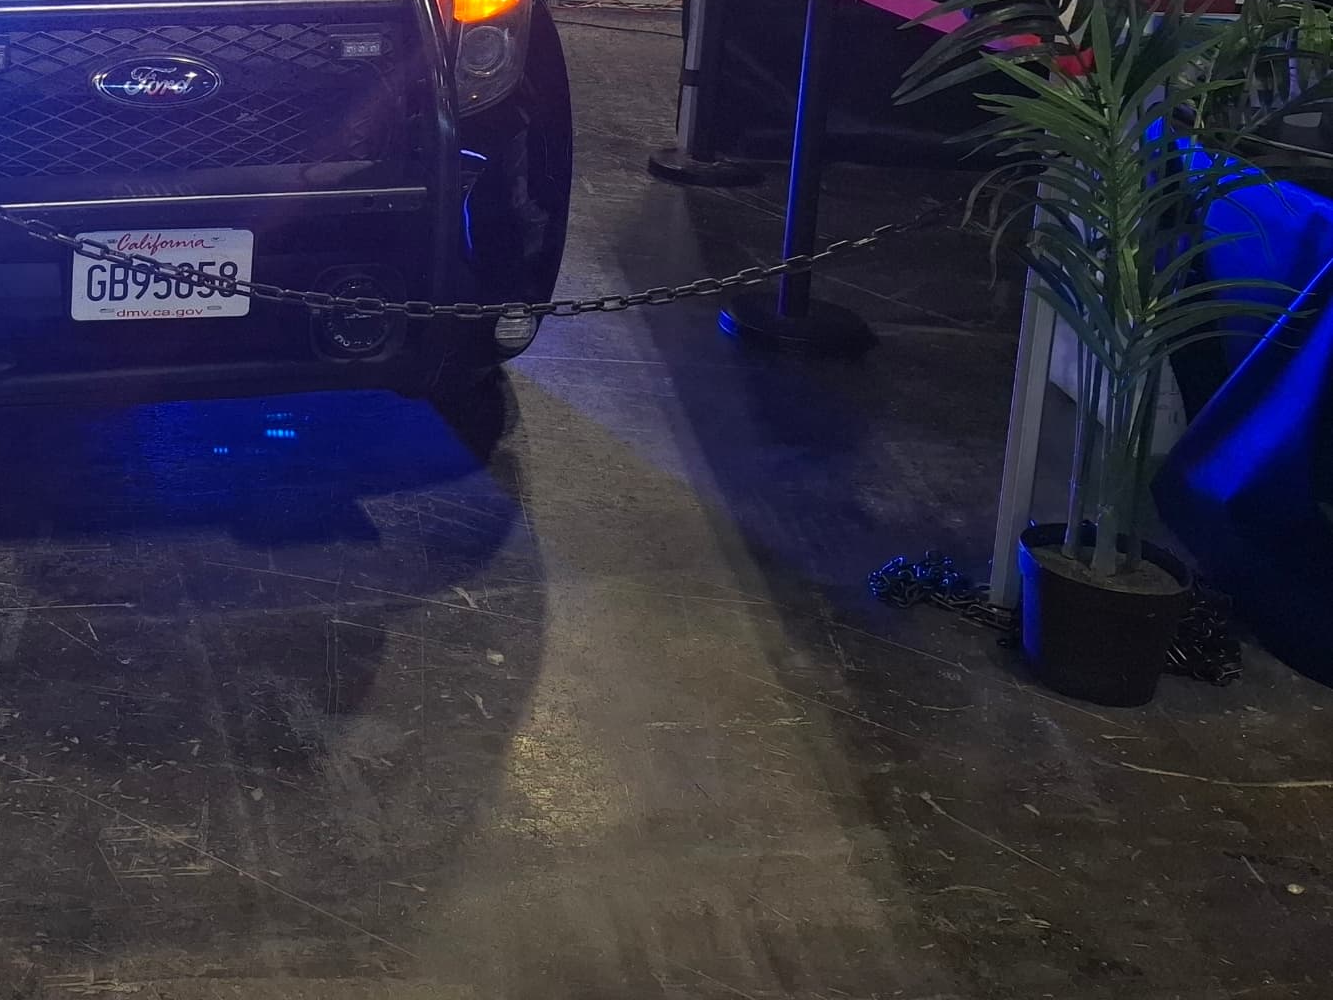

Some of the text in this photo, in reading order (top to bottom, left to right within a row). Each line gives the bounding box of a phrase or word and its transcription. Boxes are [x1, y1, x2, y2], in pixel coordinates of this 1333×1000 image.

[124, 66, 193, 96] Ford
[117, 233, 216, 255] California
[116, 308, 204, 320] dmv.ca.gov
